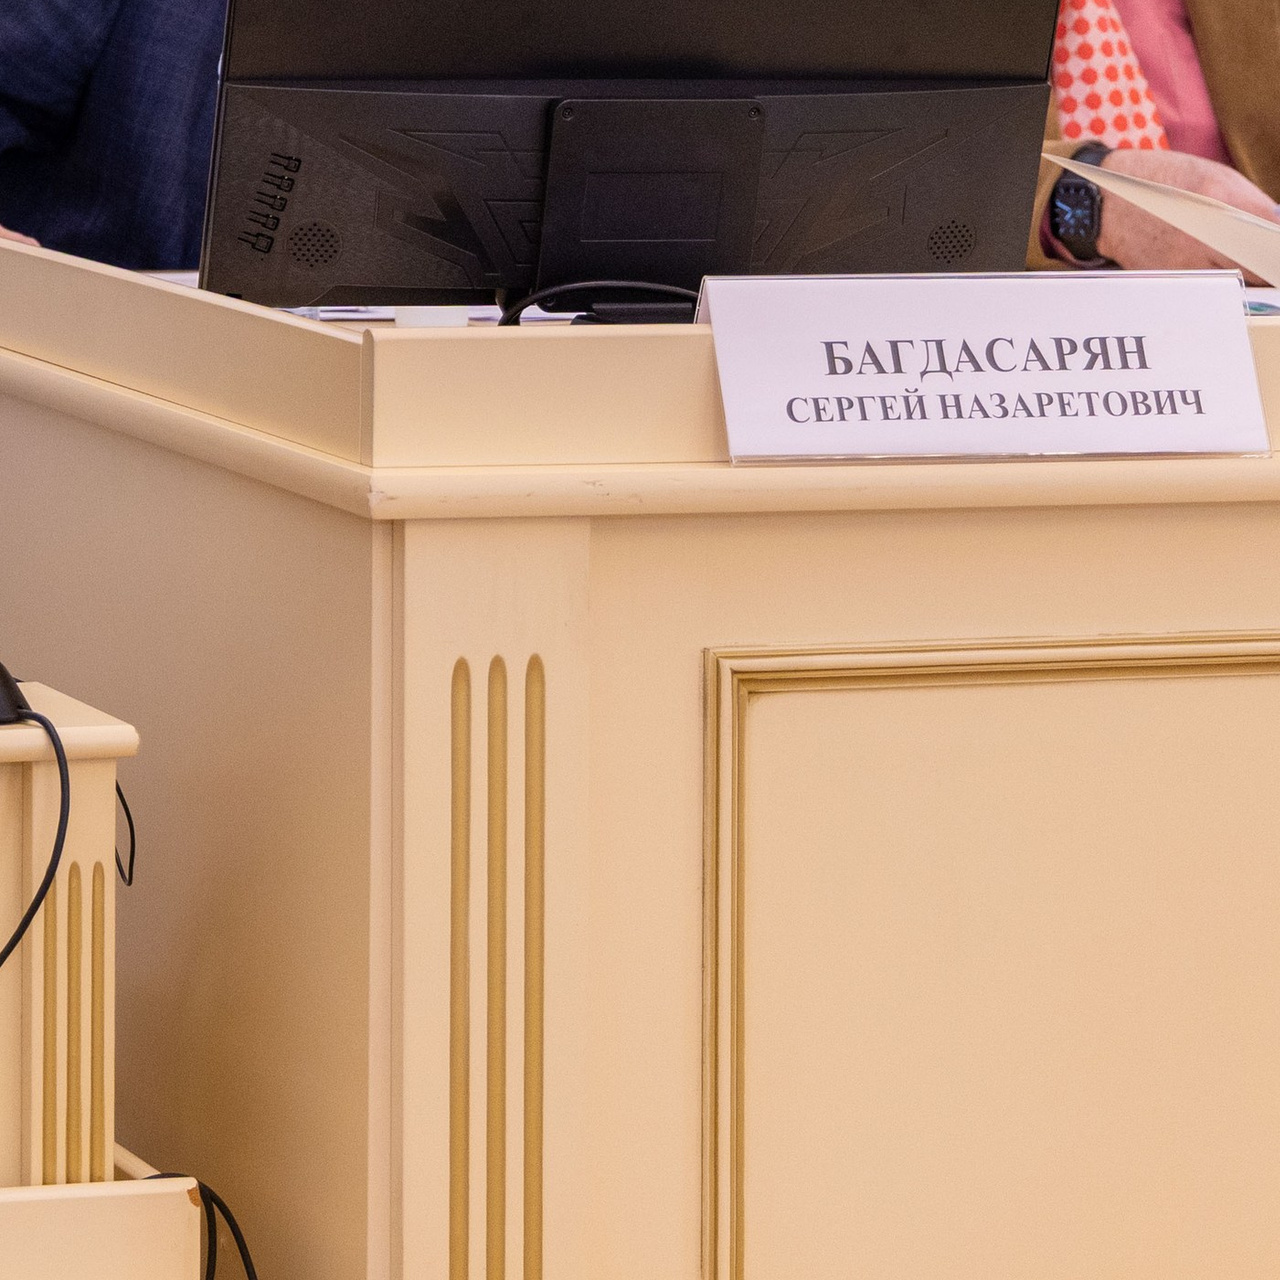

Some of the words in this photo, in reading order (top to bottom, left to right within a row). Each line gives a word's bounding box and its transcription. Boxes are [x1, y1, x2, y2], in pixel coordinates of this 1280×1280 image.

[821, 335, 1151, 382] БАГДАСАРЯН
[785, 387, 928, 424] СЕРГЕЙ
[938, 389, 1205, 421] НАЗАРЕТОВИЧ
